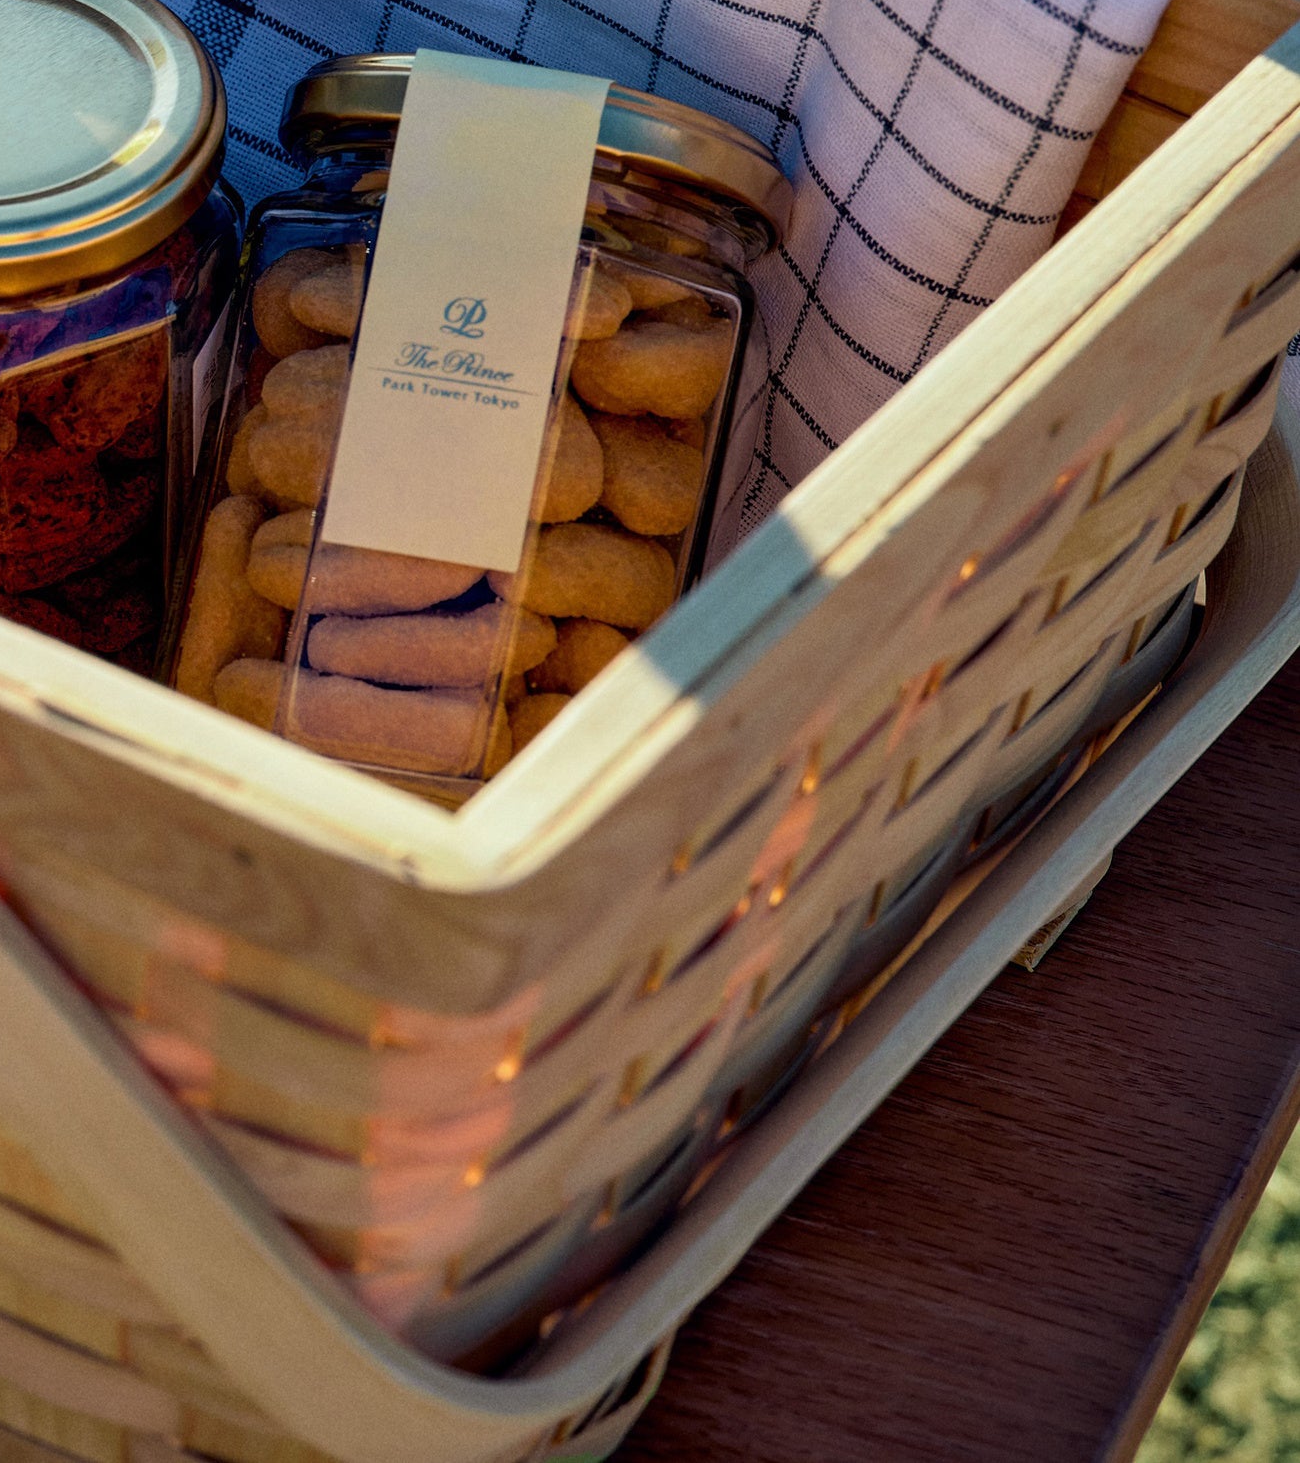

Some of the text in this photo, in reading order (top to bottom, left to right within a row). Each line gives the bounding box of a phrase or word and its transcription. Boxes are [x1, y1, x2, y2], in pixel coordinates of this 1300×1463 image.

[395, 342, 514, 382] The Prince
[382, 377, 520, 410] Park Tower Tokyo
